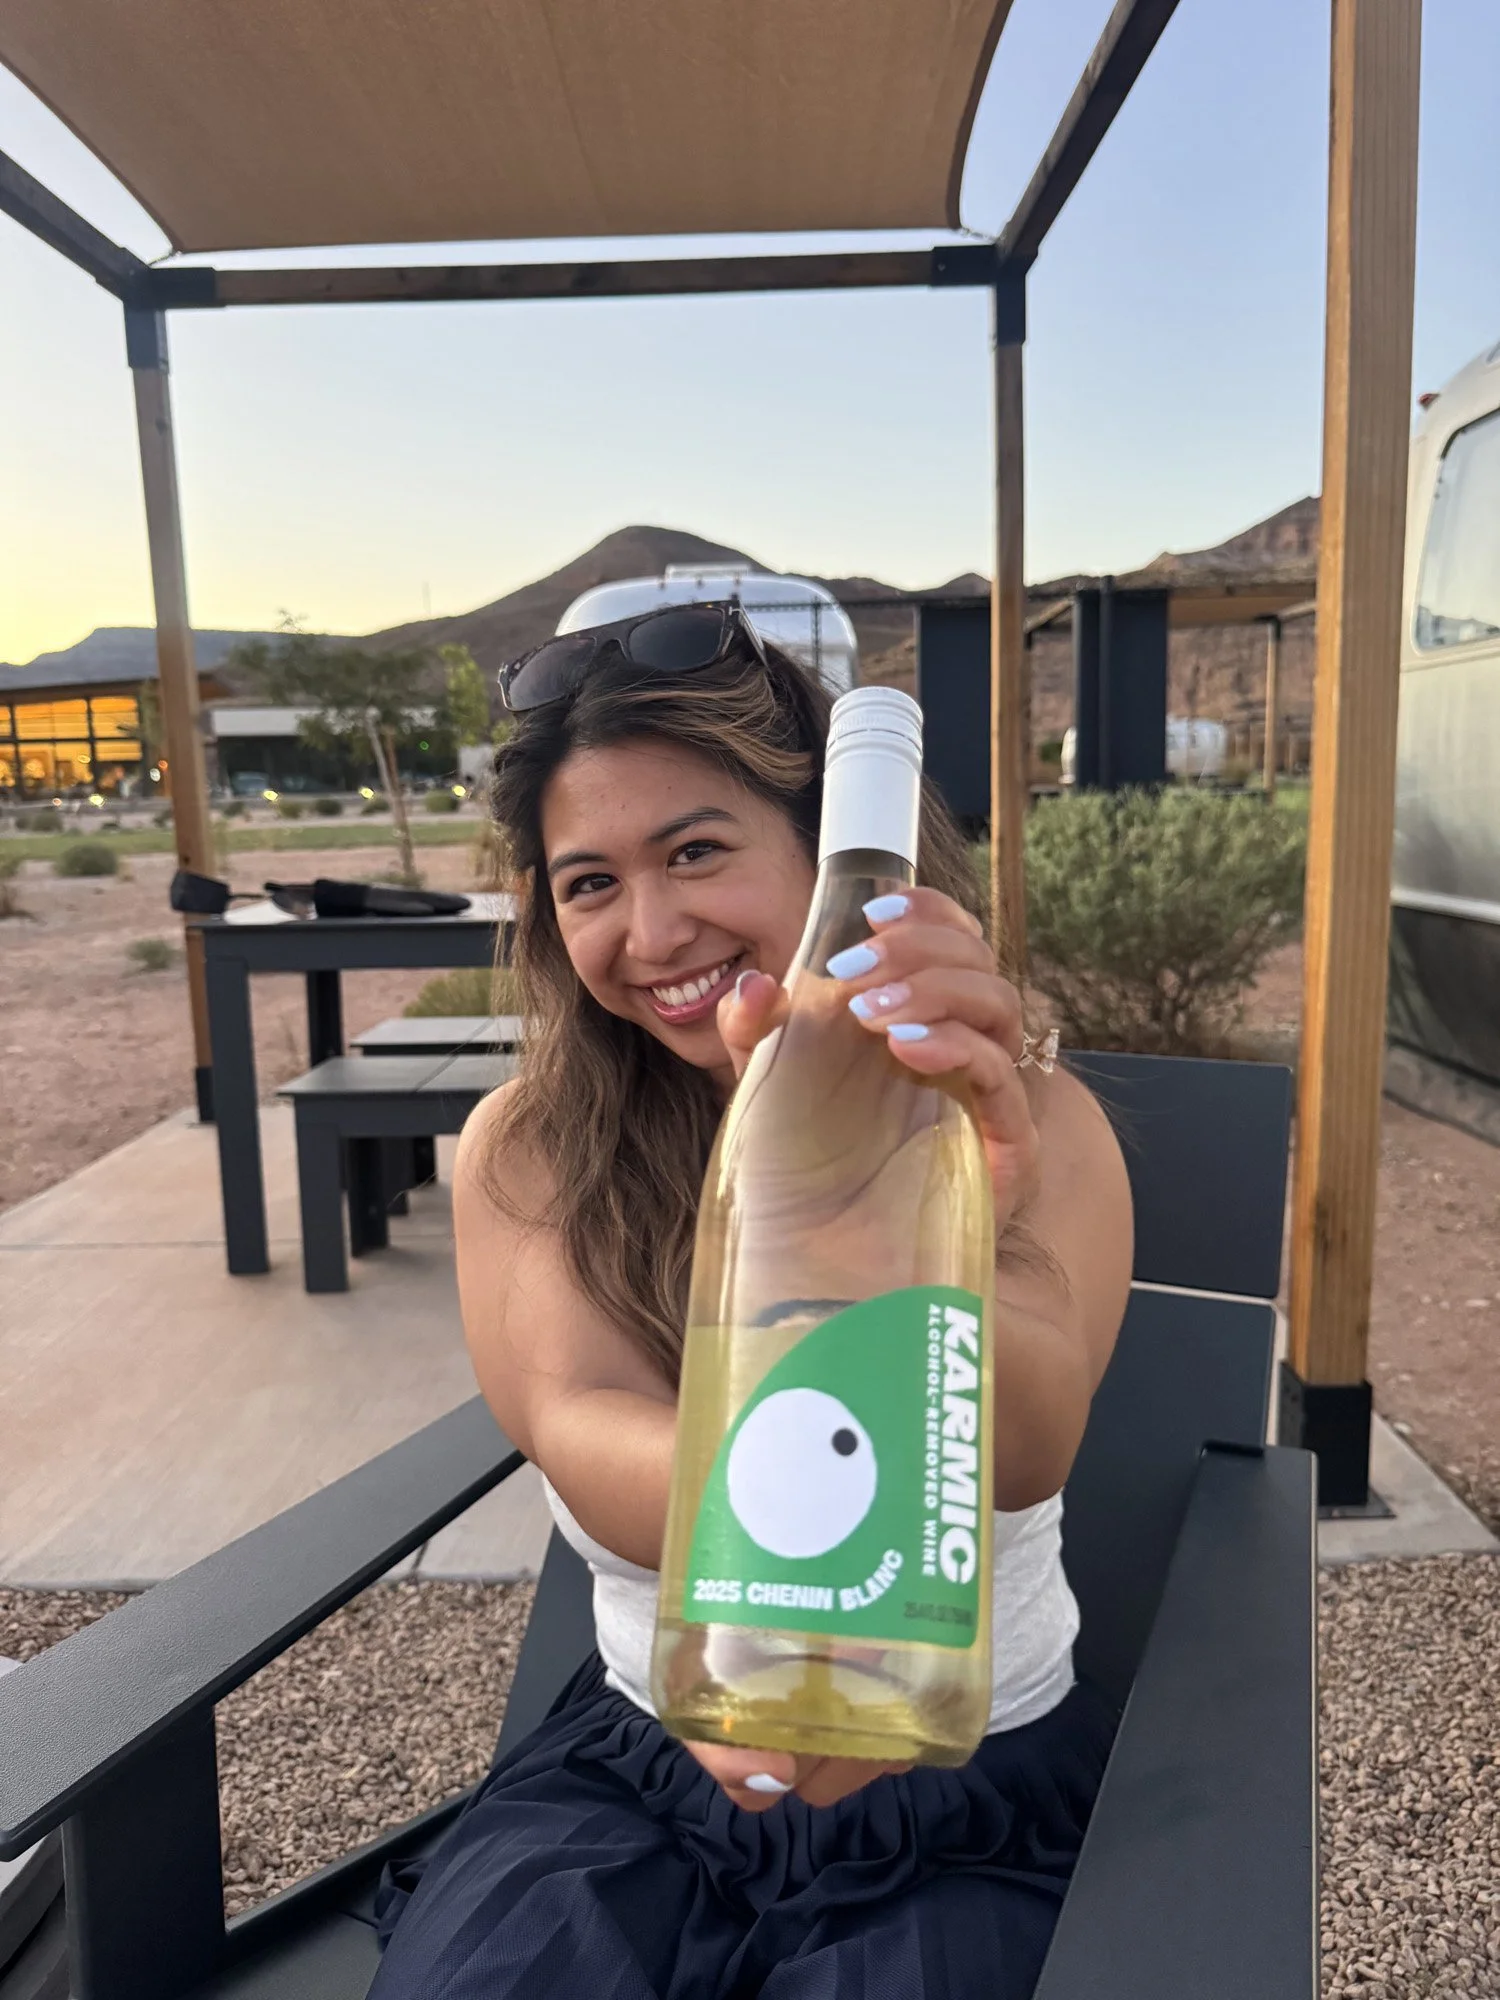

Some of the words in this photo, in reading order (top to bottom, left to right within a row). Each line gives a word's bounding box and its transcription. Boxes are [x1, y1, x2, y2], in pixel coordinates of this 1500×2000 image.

[924, 1303, 941, 1509] ALCOHOL-REMOVED
[940, 1305, 978, 1585] KARMIC
[693, 1578, 742, 1604] 2025
[747, 1581, 834, 1611] CHENIN
[838, 1549, 903, 1612] BLANC
[922, 1519, 937, 1576] WINE
